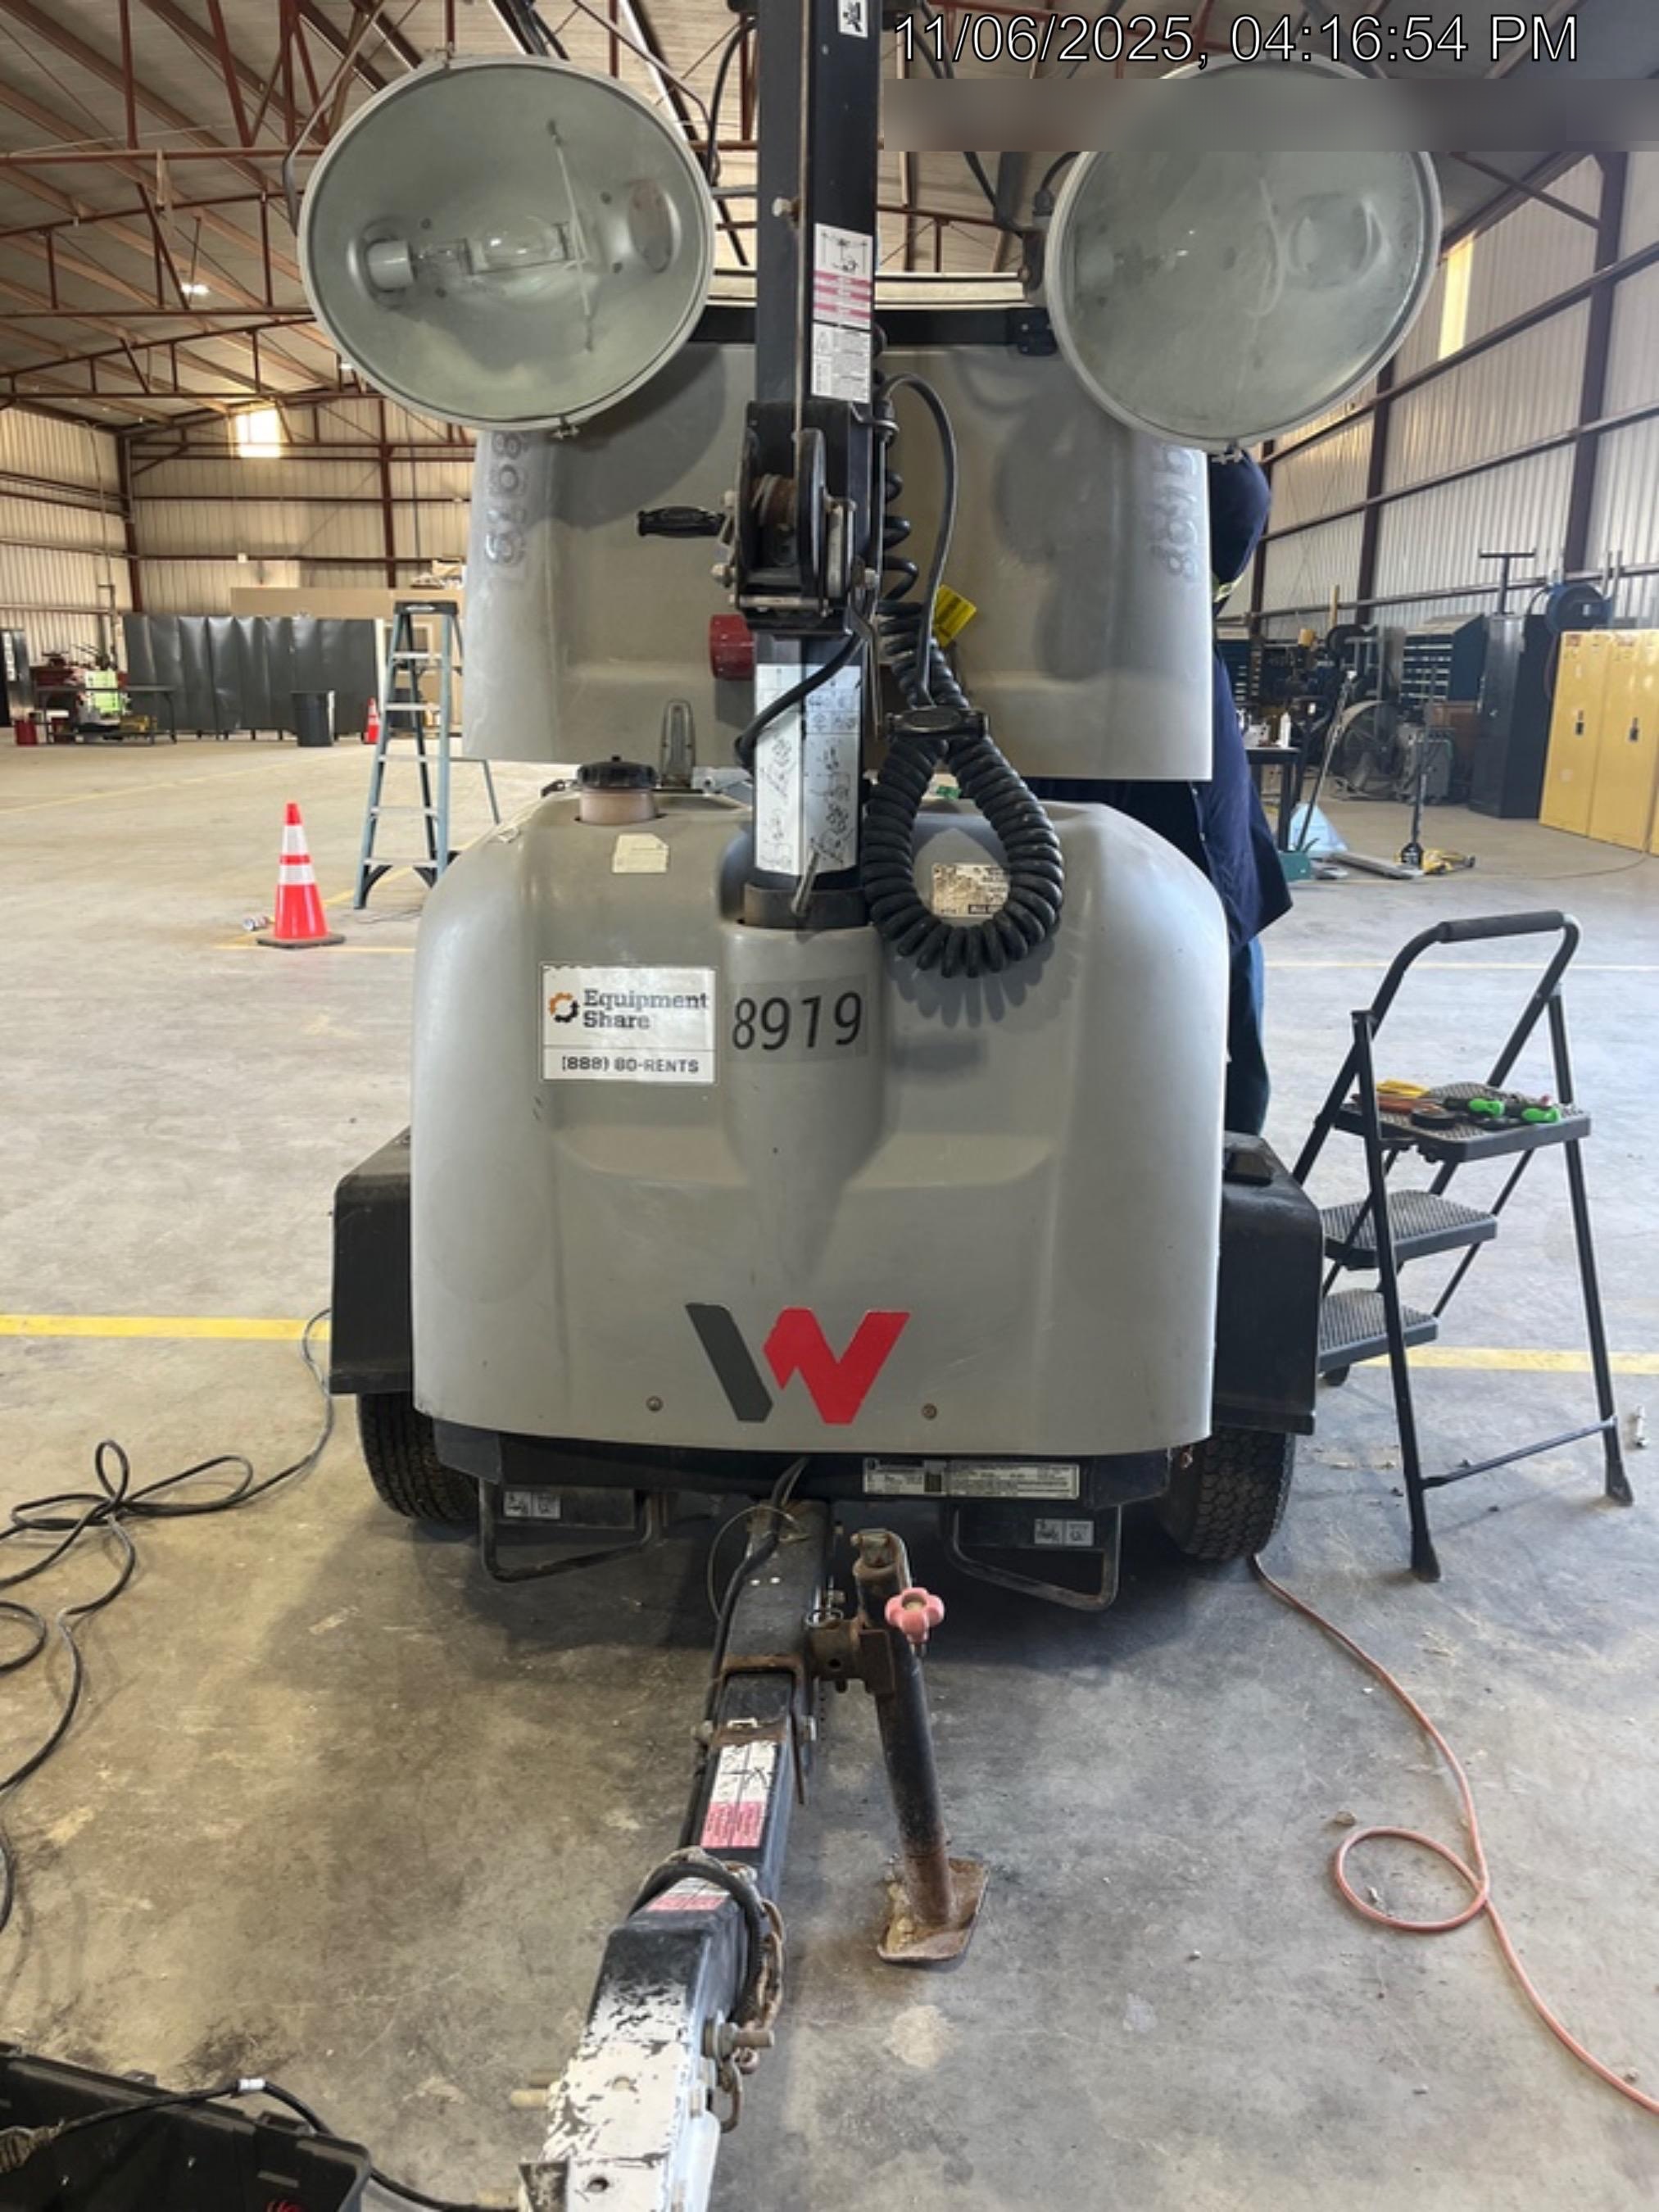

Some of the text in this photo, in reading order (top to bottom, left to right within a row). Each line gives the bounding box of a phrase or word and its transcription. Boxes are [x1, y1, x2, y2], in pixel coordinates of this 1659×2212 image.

[582, 989, 709, 1011] Equipment
[582, 1009, 650, 1029] Share
[732, 990, 863, 1050] 8919
[562, 1055, 610, 1072] (888)
